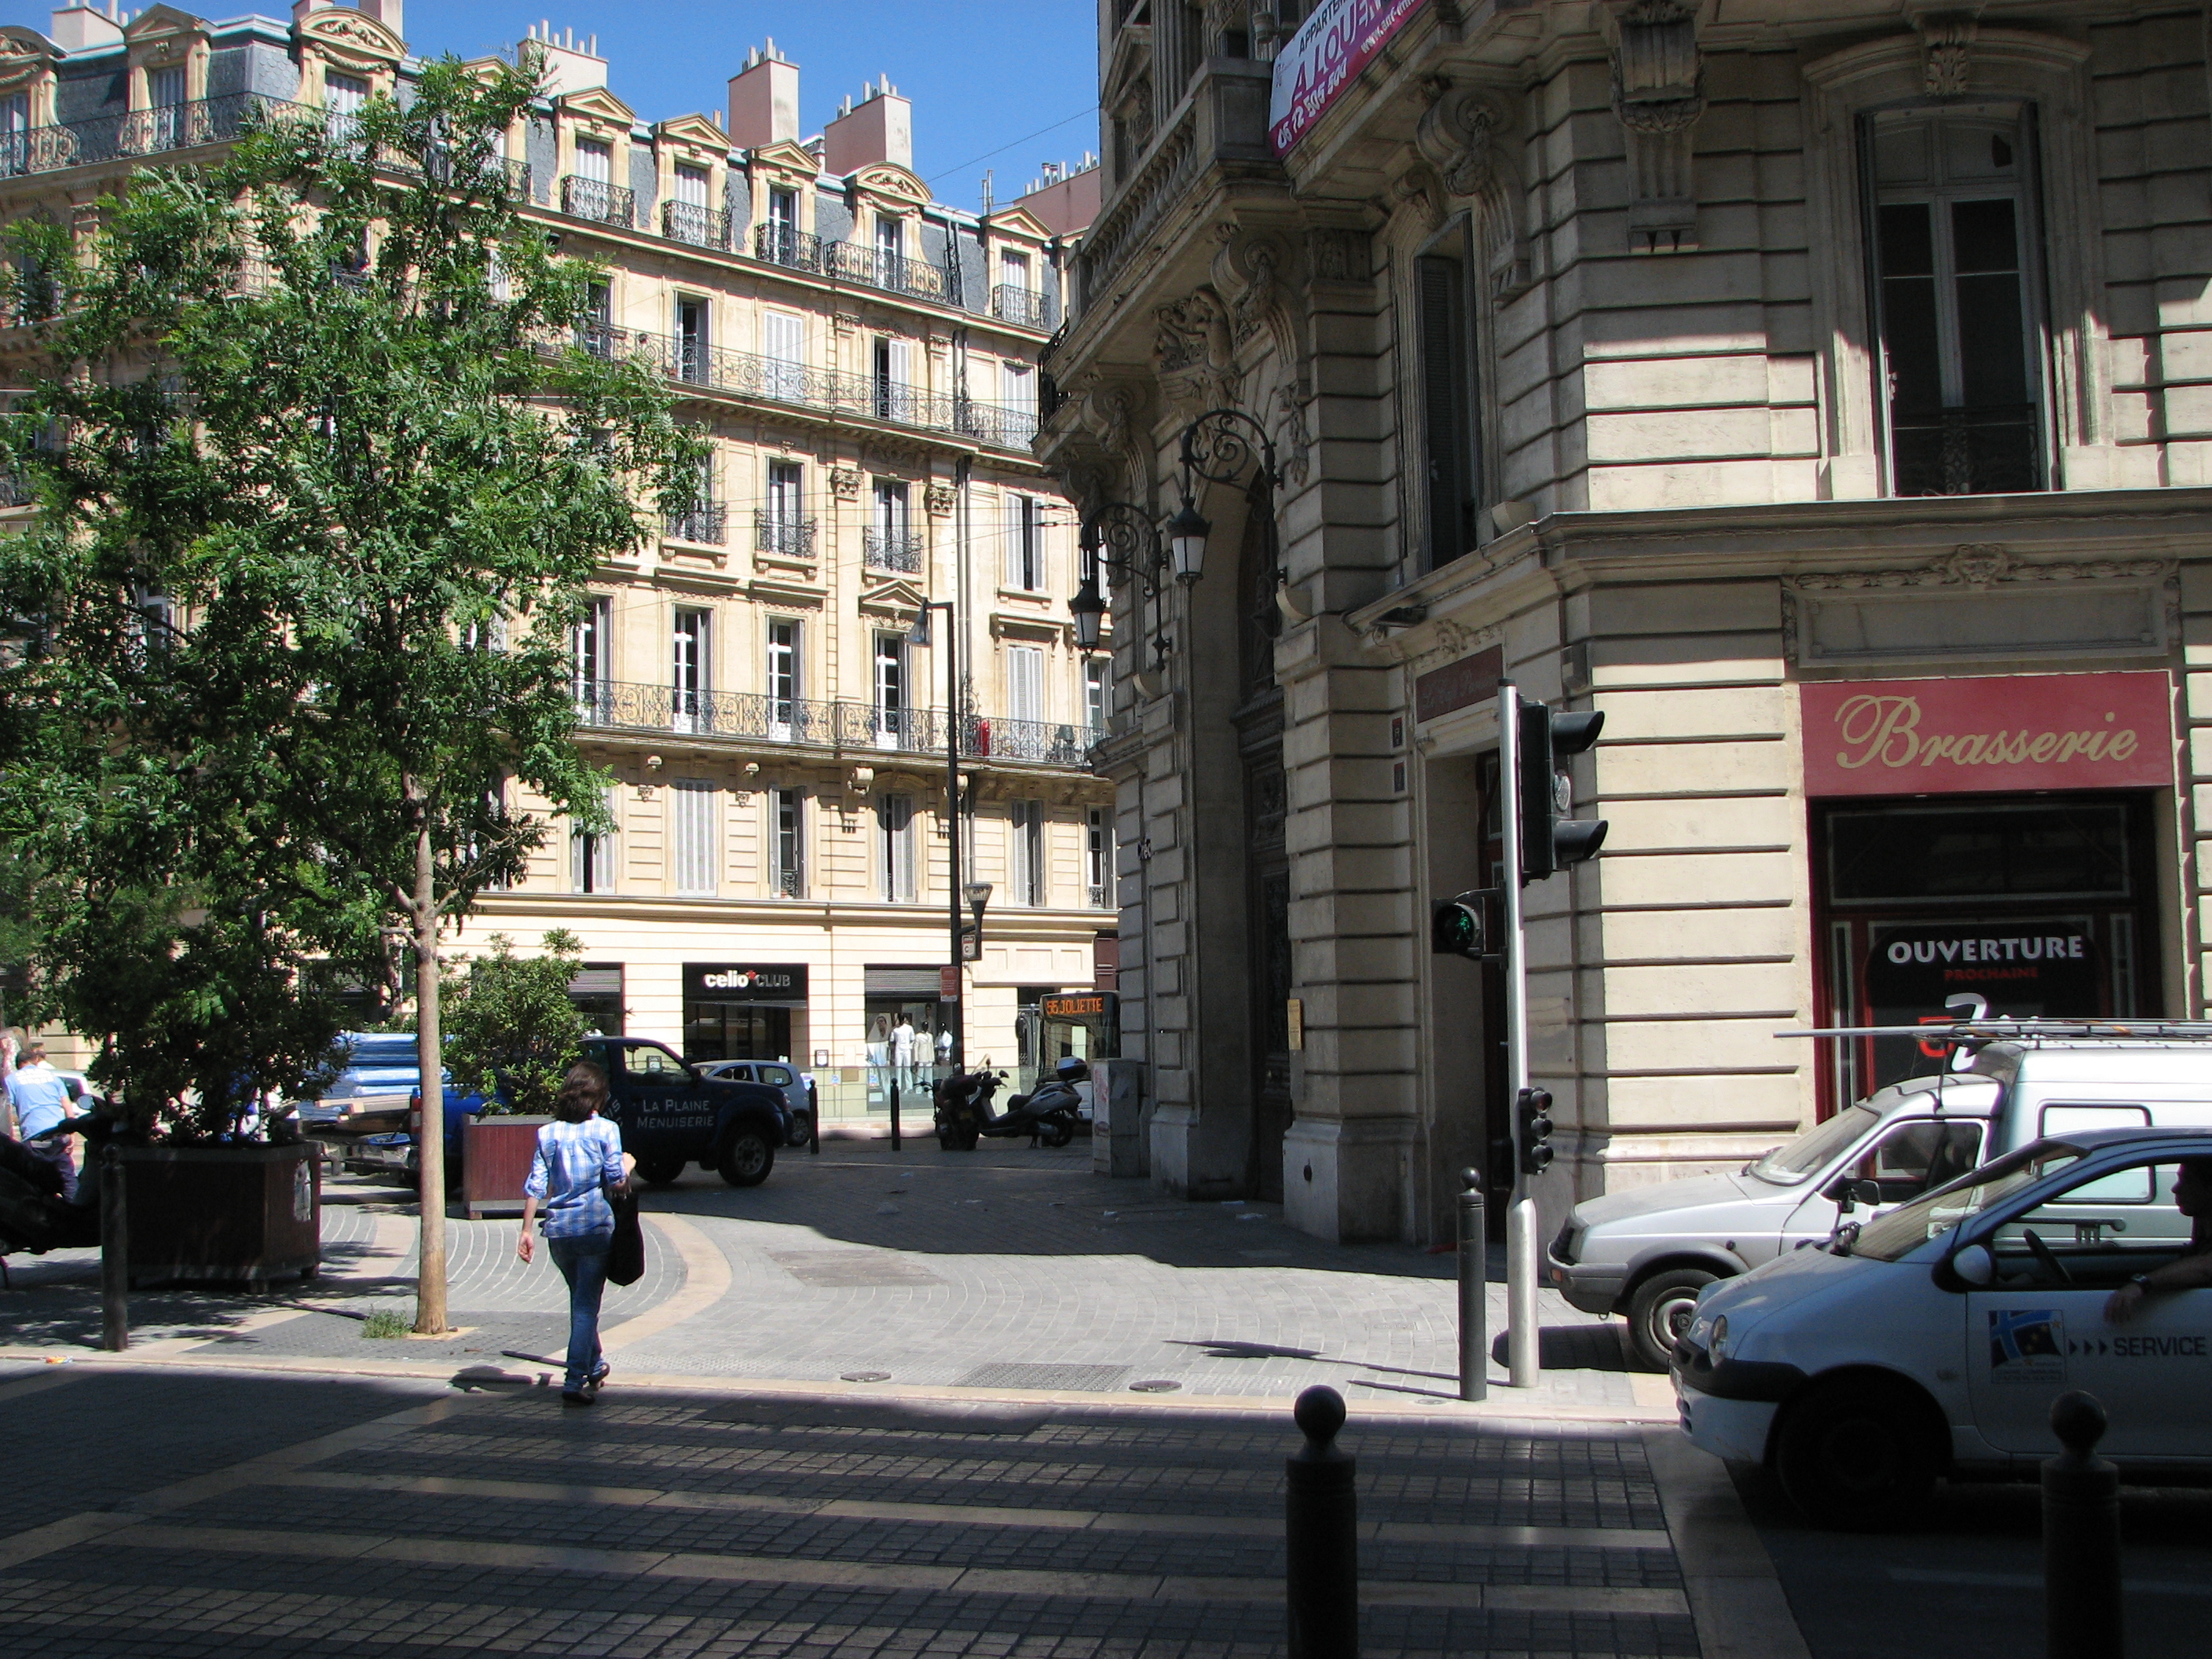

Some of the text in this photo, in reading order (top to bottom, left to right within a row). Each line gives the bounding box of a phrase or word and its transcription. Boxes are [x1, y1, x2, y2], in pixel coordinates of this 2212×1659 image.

[1277, 120, 1293, 149] 06
[1303, 81, 1326, 118] 505
[1328, 57, 1347, 95] 500
[1834, 694, 2139, 769] Brasserie
[1888, 936, 2084, 964] OUVERTURE
[704, 969, 791, 987] celio CLUB
[1944, 967, 2039, 980] PROCHAINE
[1060, 997, 1103, 1013] JOLIETTE
[665, 1100, 710, 1111] PLAINE
[637, 1116, 714, 1128] MENUISERIE
[2114, 1335, 2207, 1357] SERVICE
